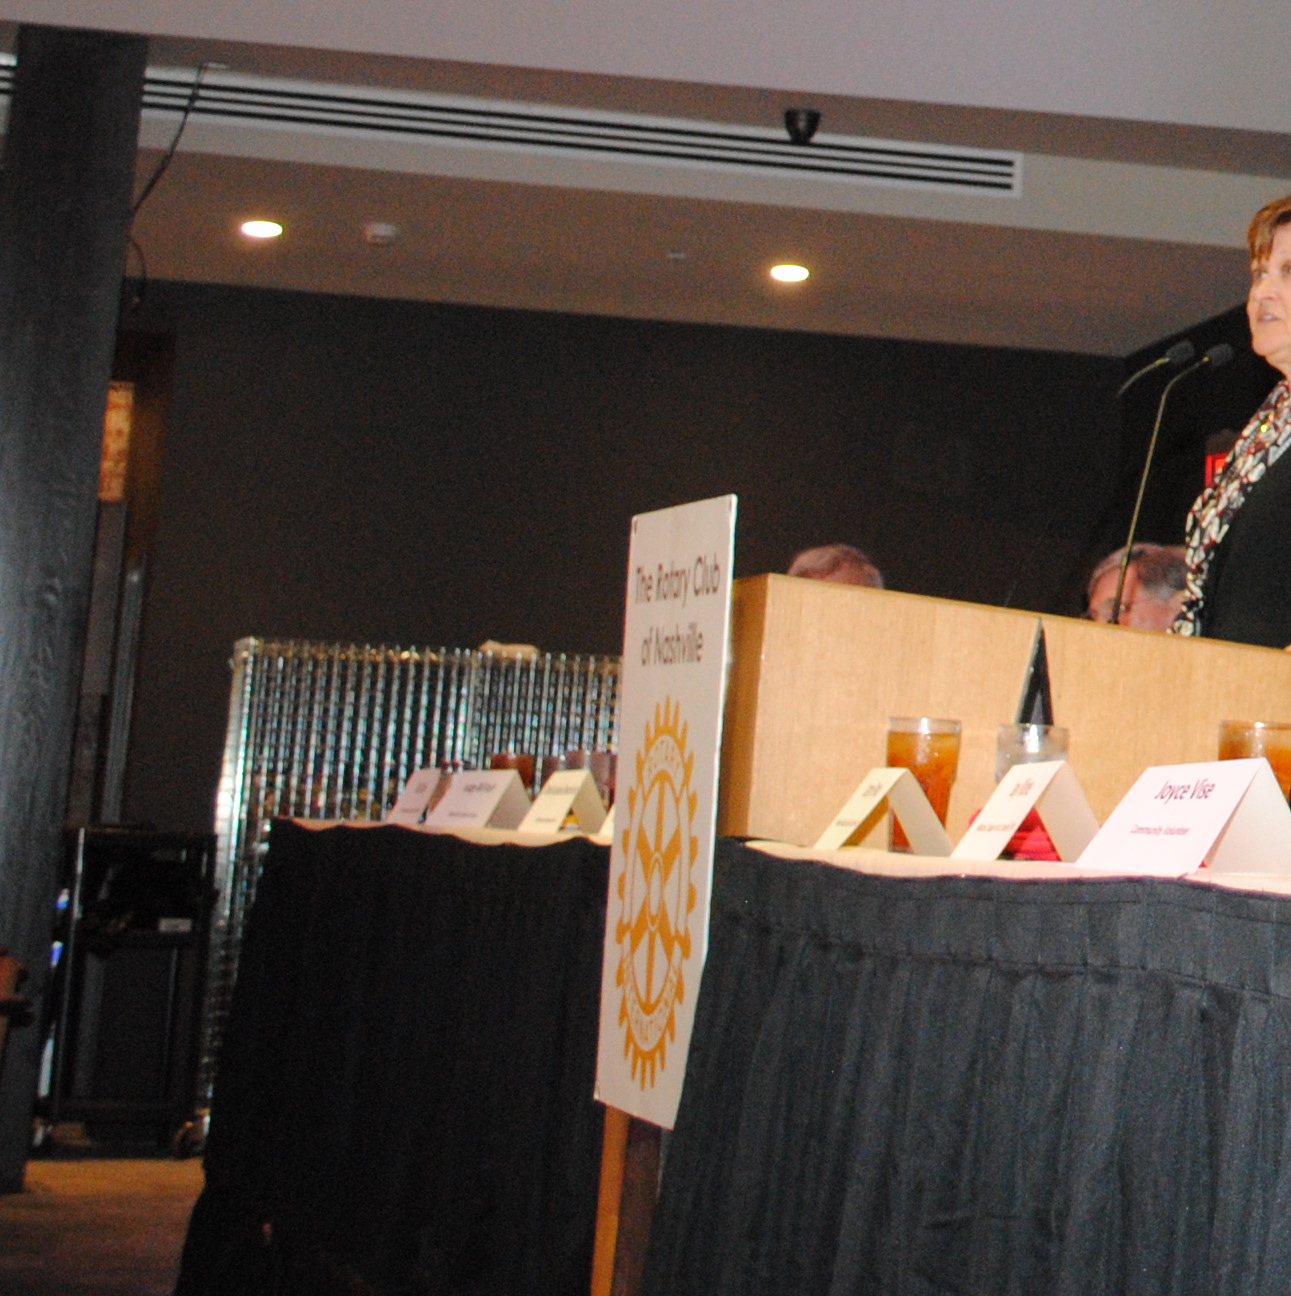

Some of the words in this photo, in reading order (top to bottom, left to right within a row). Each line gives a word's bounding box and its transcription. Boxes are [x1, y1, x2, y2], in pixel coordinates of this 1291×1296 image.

[635, 566, 653, 604] The
[656, 560, 690, 608] Rotary
[693, 553, 720, 596] Club
[641, 625, 654, 666] of
[654, 622, 704, 665] Nashville
[1154, 780, 1191, 805] Joyce
